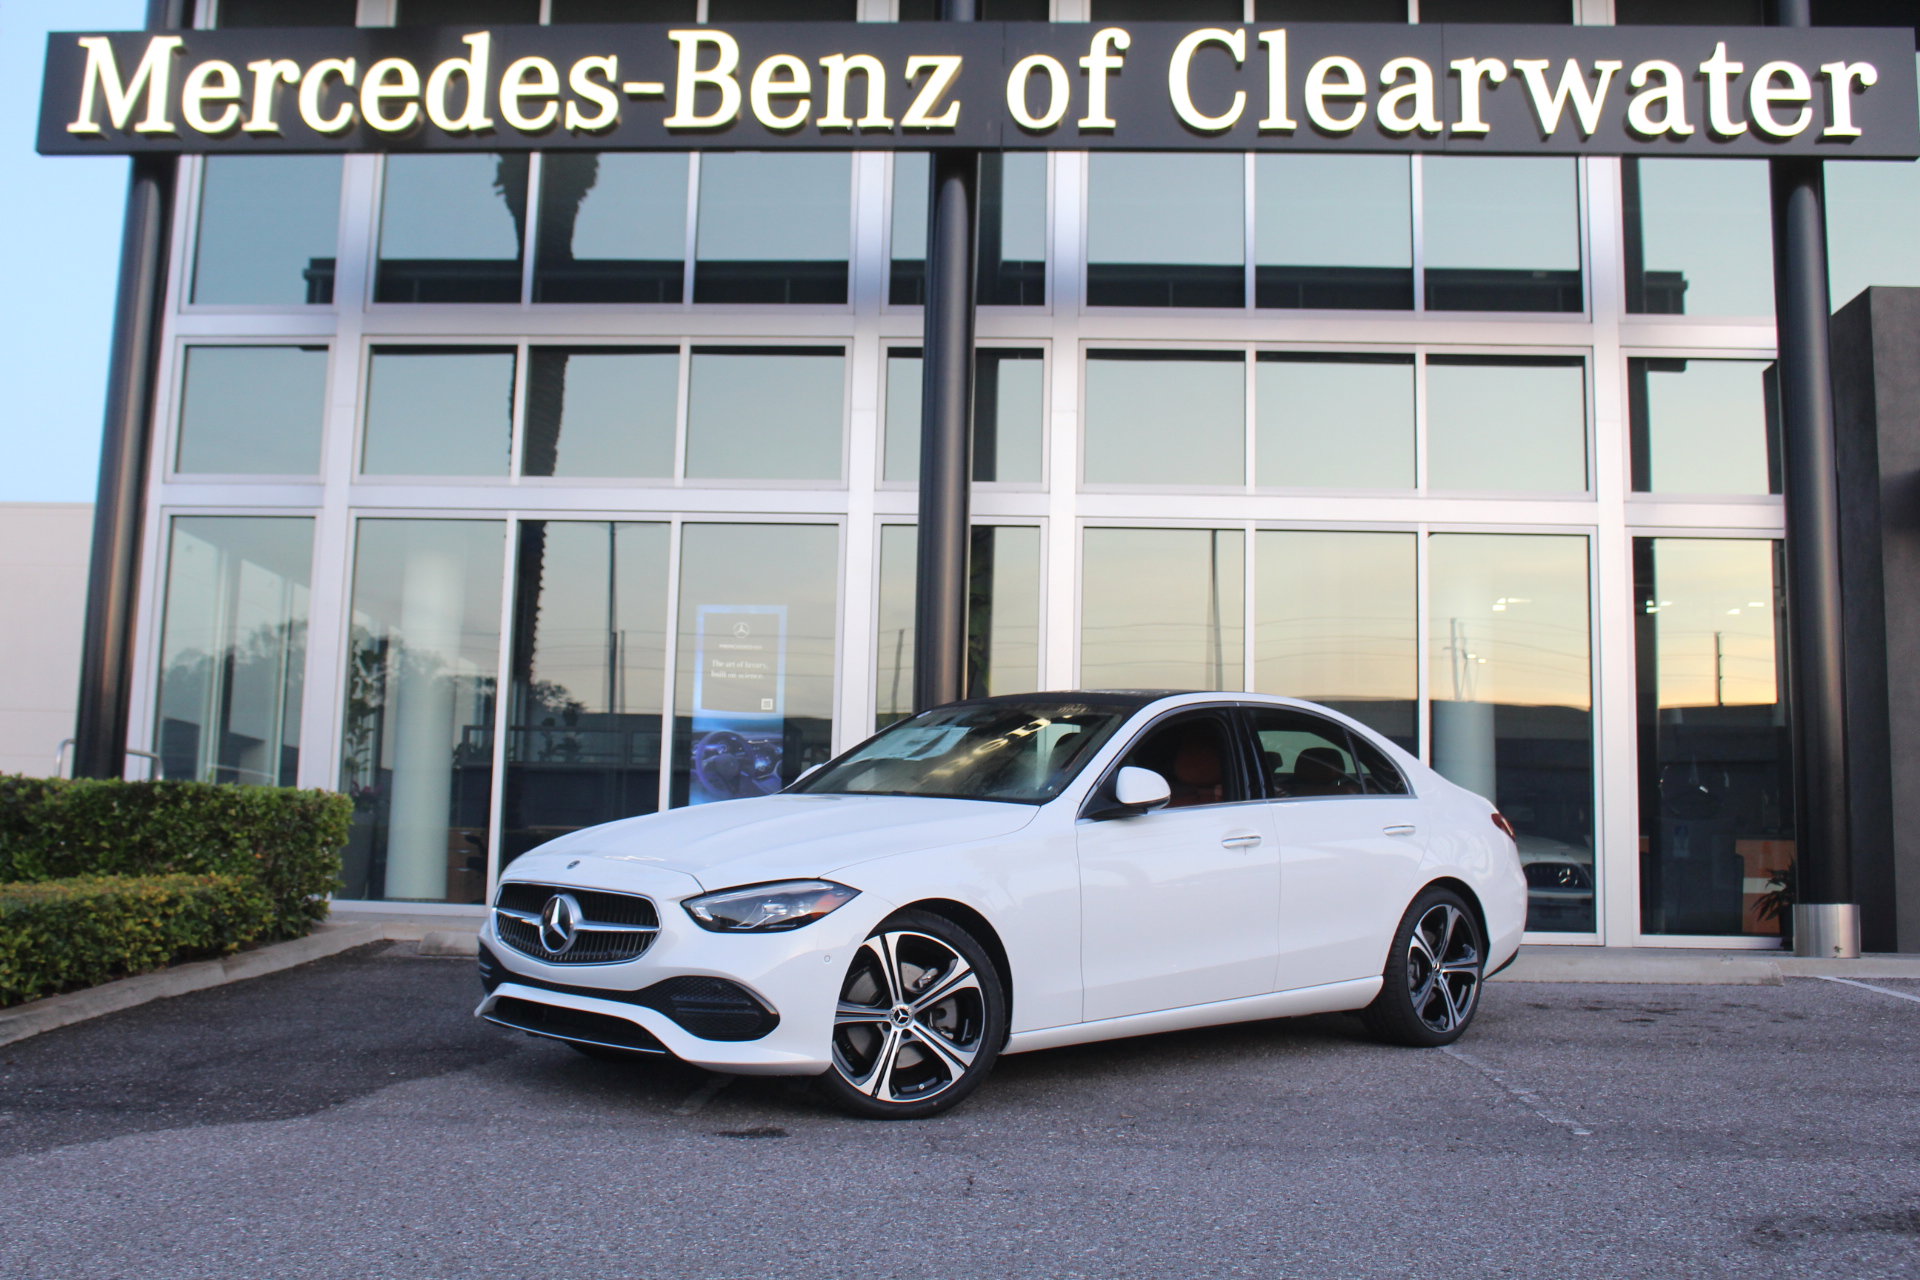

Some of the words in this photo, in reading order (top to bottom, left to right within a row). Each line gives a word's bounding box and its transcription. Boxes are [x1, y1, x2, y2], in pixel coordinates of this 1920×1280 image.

[66, 30, 964, 133] Mercedes-Benz
[1005, 28, 1132, 130] of
[1167, 28, 1879, 137] Clearwater
